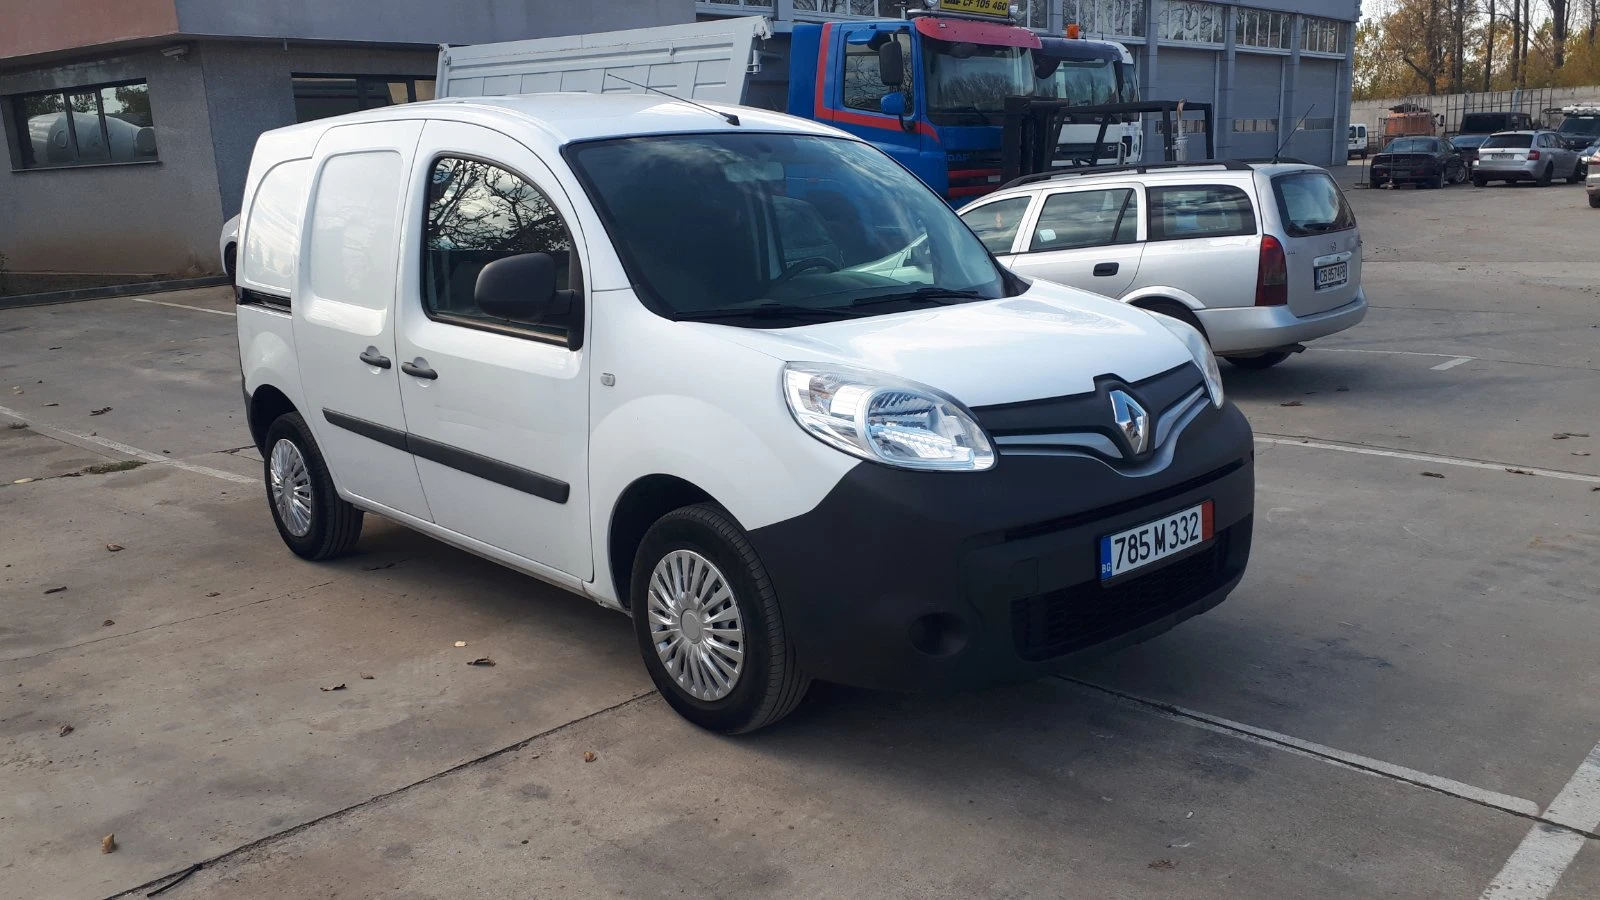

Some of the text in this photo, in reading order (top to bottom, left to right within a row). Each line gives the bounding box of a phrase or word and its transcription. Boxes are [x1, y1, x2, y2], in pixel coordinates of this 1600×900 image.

[976, 0, 990, 8] 105
[992, 1, 1007, 10] 460
[948, 152, 970, 161] DAF
[1114, 511, 1199, 570] 785 M 332
[1101, 562, 1111, 574] BG
